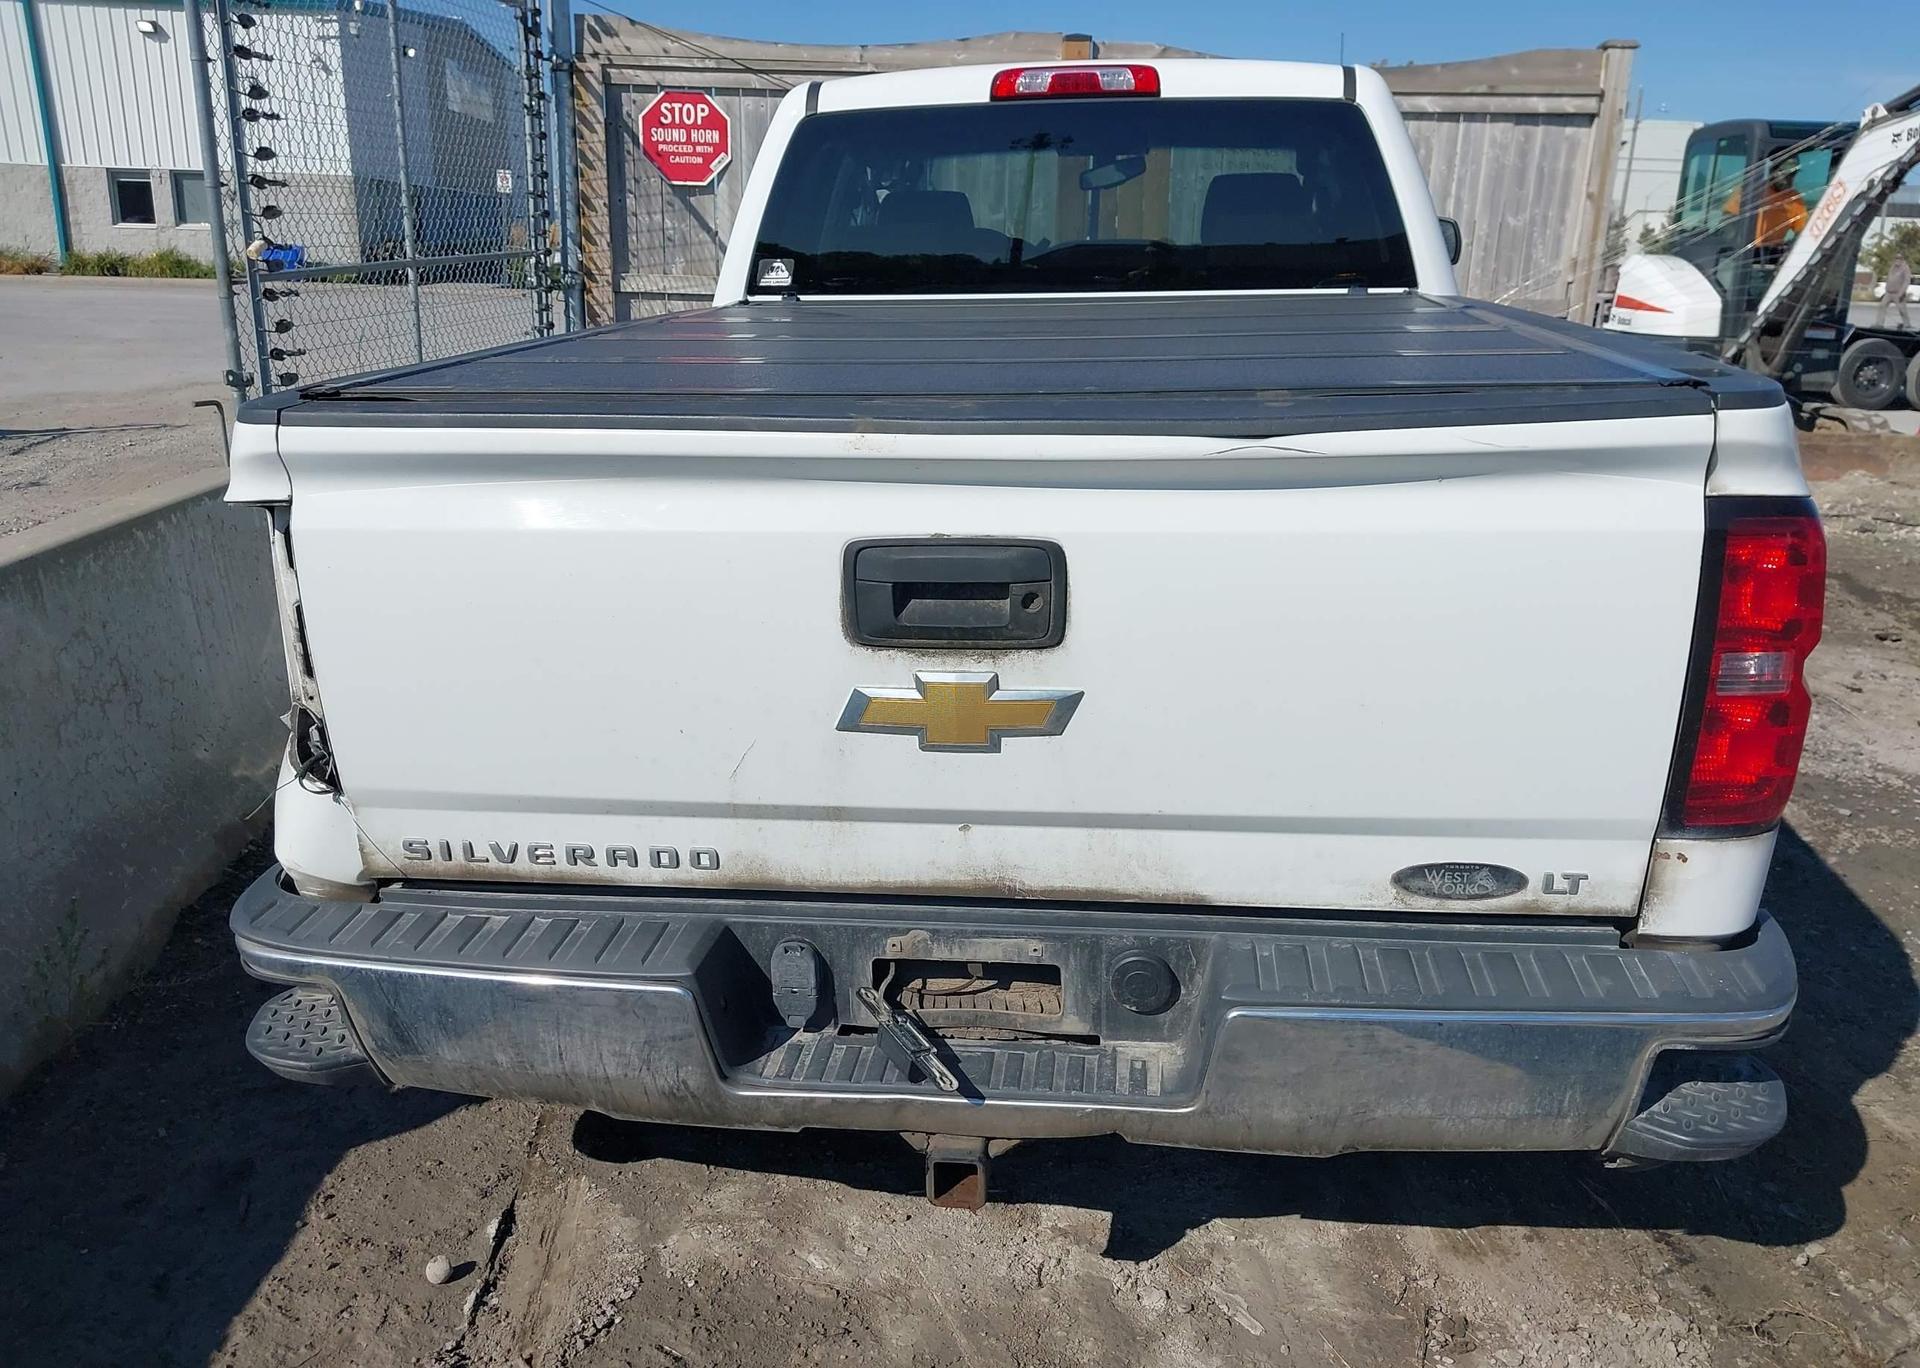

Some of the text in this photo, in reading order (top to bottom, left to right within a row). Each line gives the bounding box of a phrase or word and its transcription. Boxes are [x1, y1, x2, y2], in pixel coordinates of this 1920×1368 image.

[660, 102, 710, 125] STOP
[650, 128, 720, 144] SOUND HORN
[658, 144, 714, 153] PROCEED WITH
[669, 155, 703, 164] CAUTION
[401, 837, 721, 871] SILVERADO
[1424, 868, 1471, 884] WEST
[1541, 871, 1590, 896] LT
[1431, 880, 1475, 895] YORK
